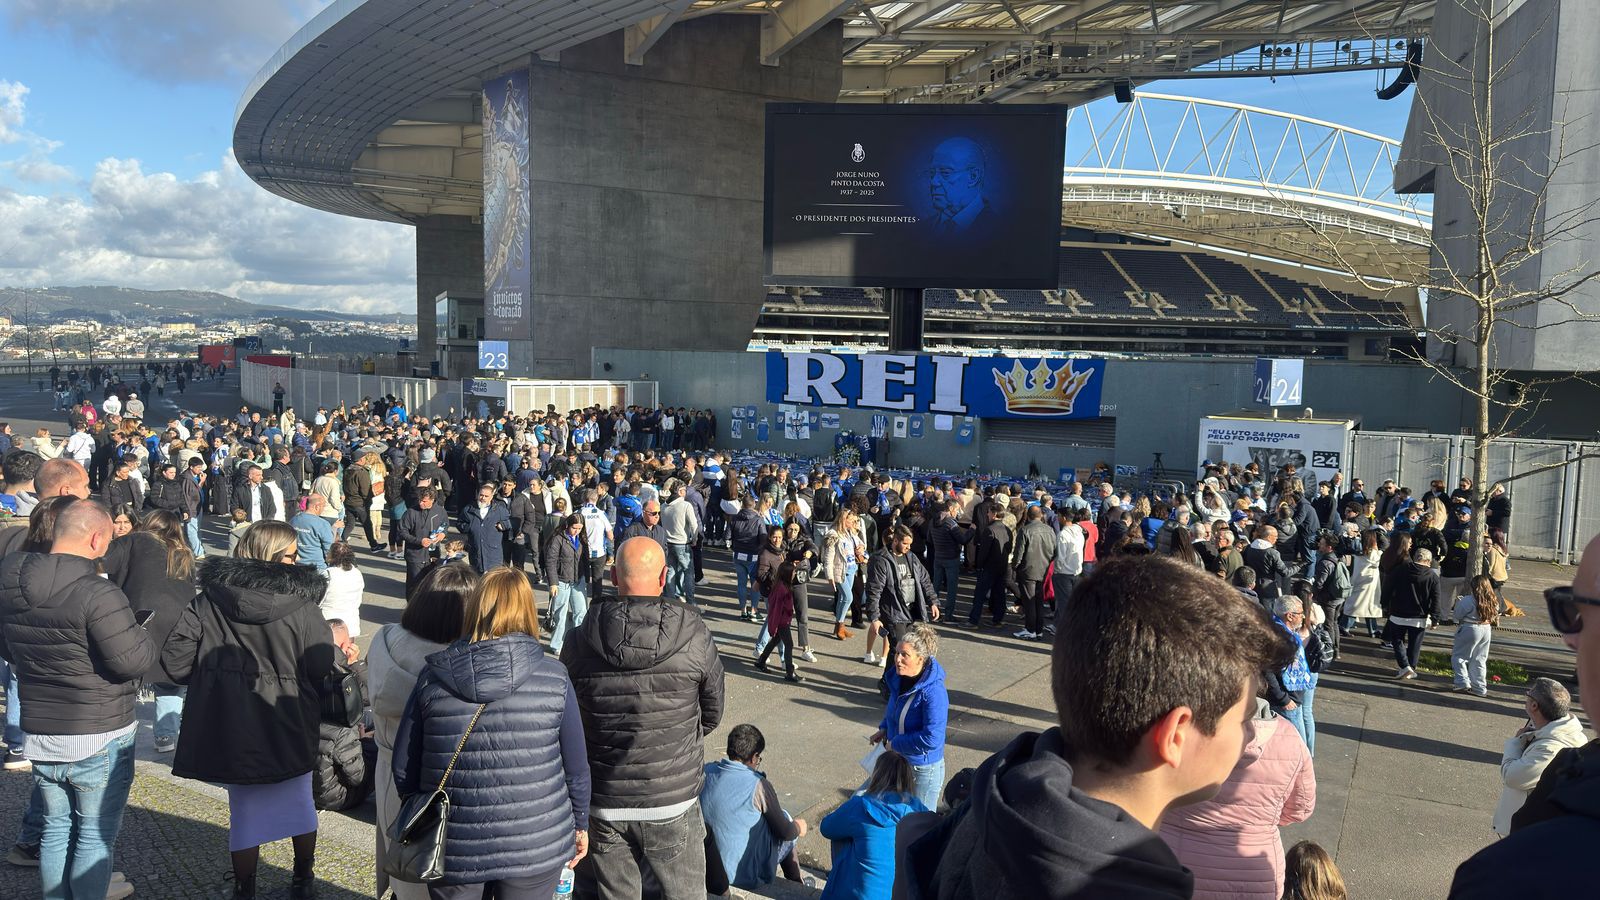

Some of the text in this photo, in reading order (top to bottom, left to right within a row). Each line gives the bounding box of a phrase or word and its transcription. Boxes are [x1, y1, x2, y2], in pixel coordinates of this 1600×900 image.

[247, 341, 258, 350] 22
[484, 352, 507, 369] 23
[782, 352, 971, 414] REI
[1256, 378, 1270, 403] 24
[1276, 378, 1300, 404] 24
[1313, 456, 1339, 467] 24
